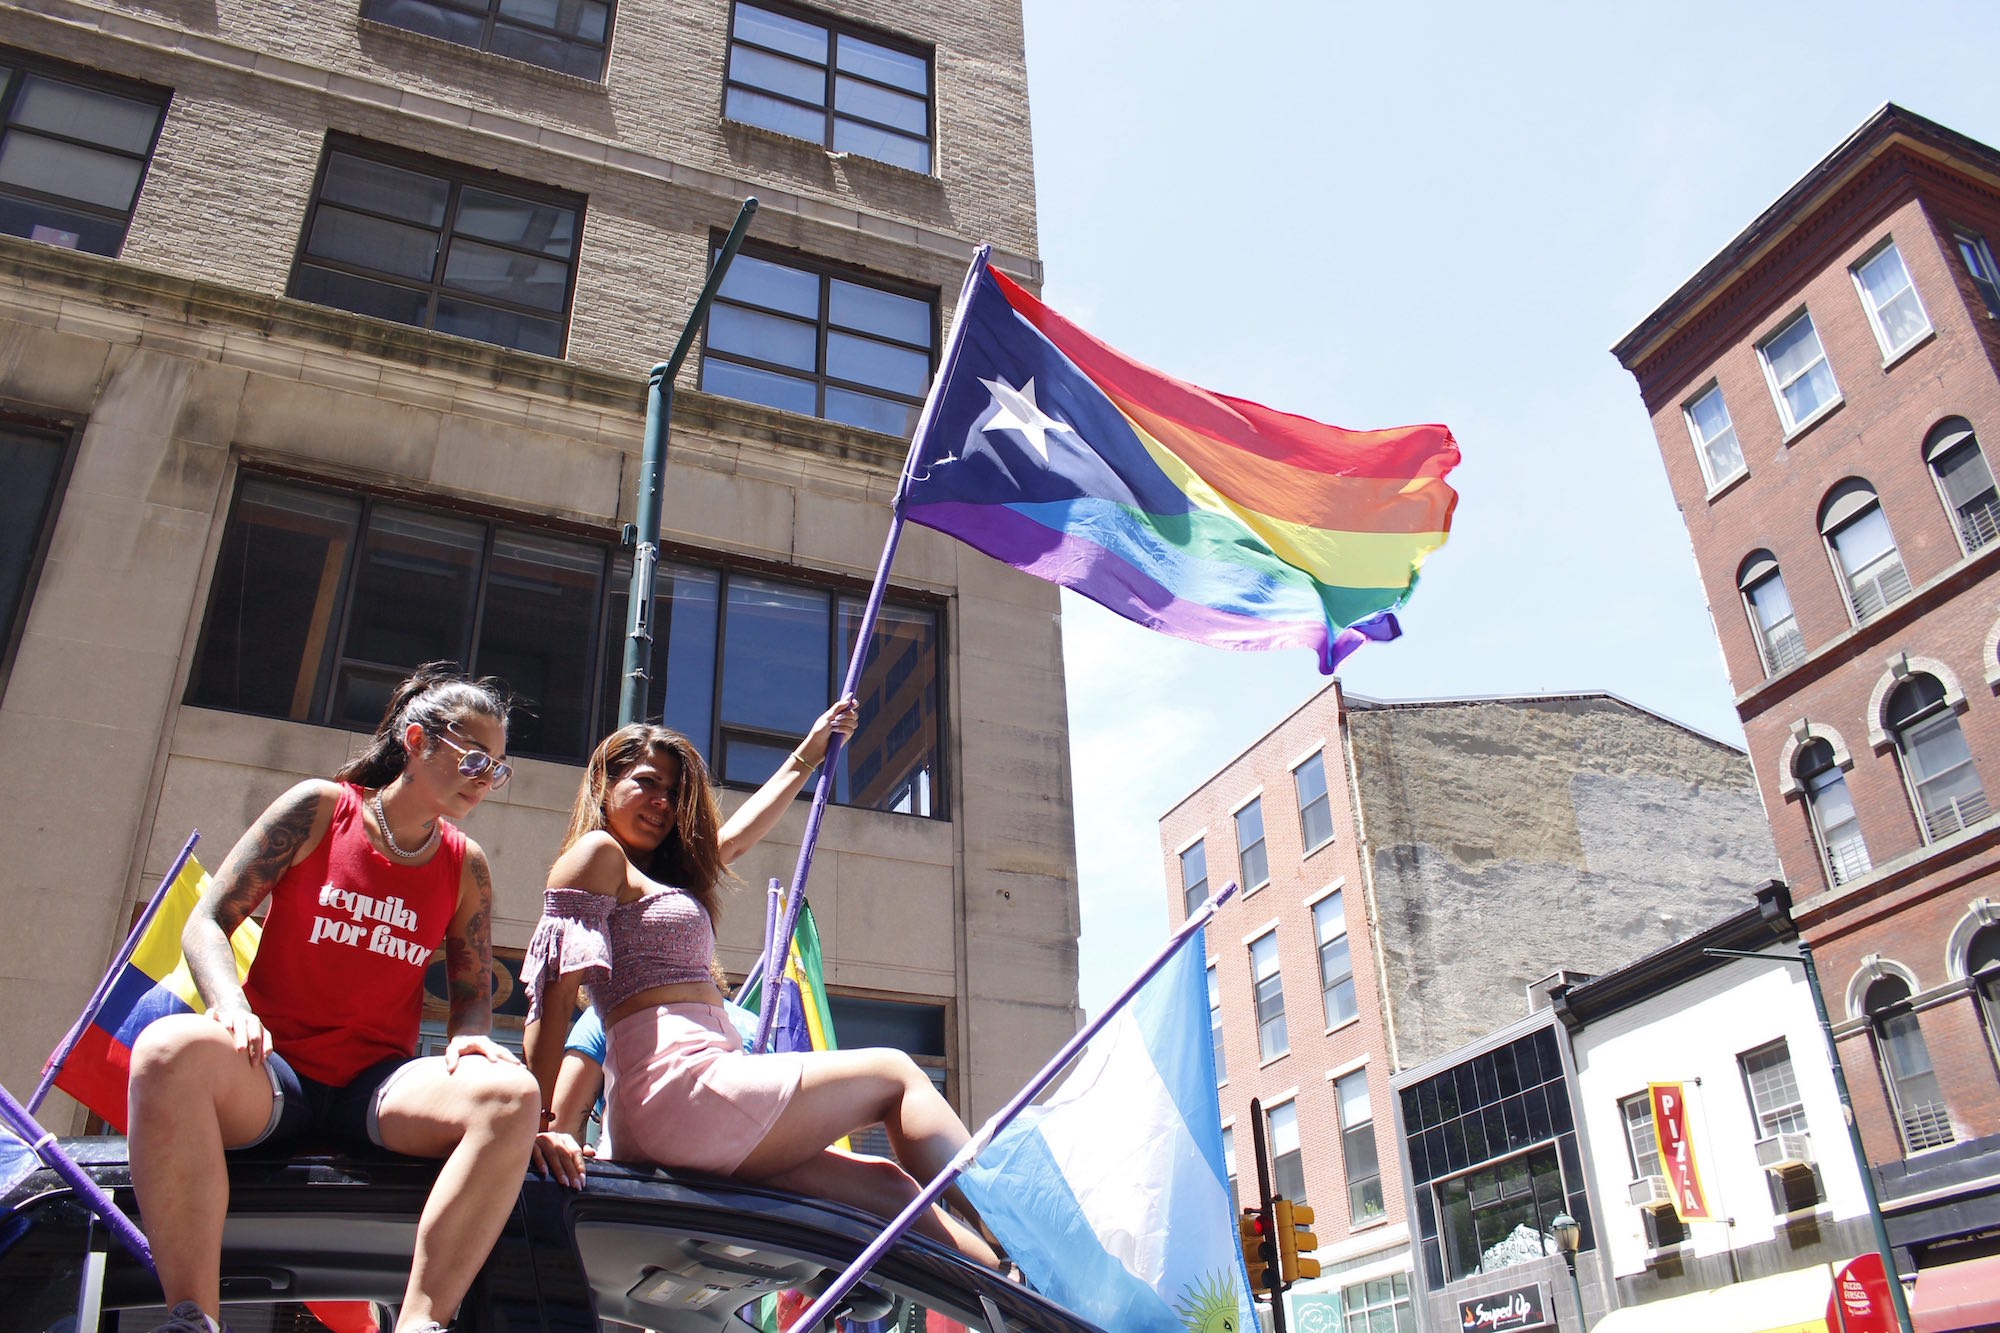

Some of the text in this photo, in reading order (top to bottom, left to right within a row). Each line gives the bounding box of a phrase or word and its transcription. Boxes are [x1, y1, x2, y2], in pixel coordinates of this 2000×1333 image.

[318, 880, 418, 932] tequila
[308, 915, 432, 967] por favor
[1662, 1095, 1699, 1210] PIZZA
[1476, 1293, 1531, 1330] Souped Up
